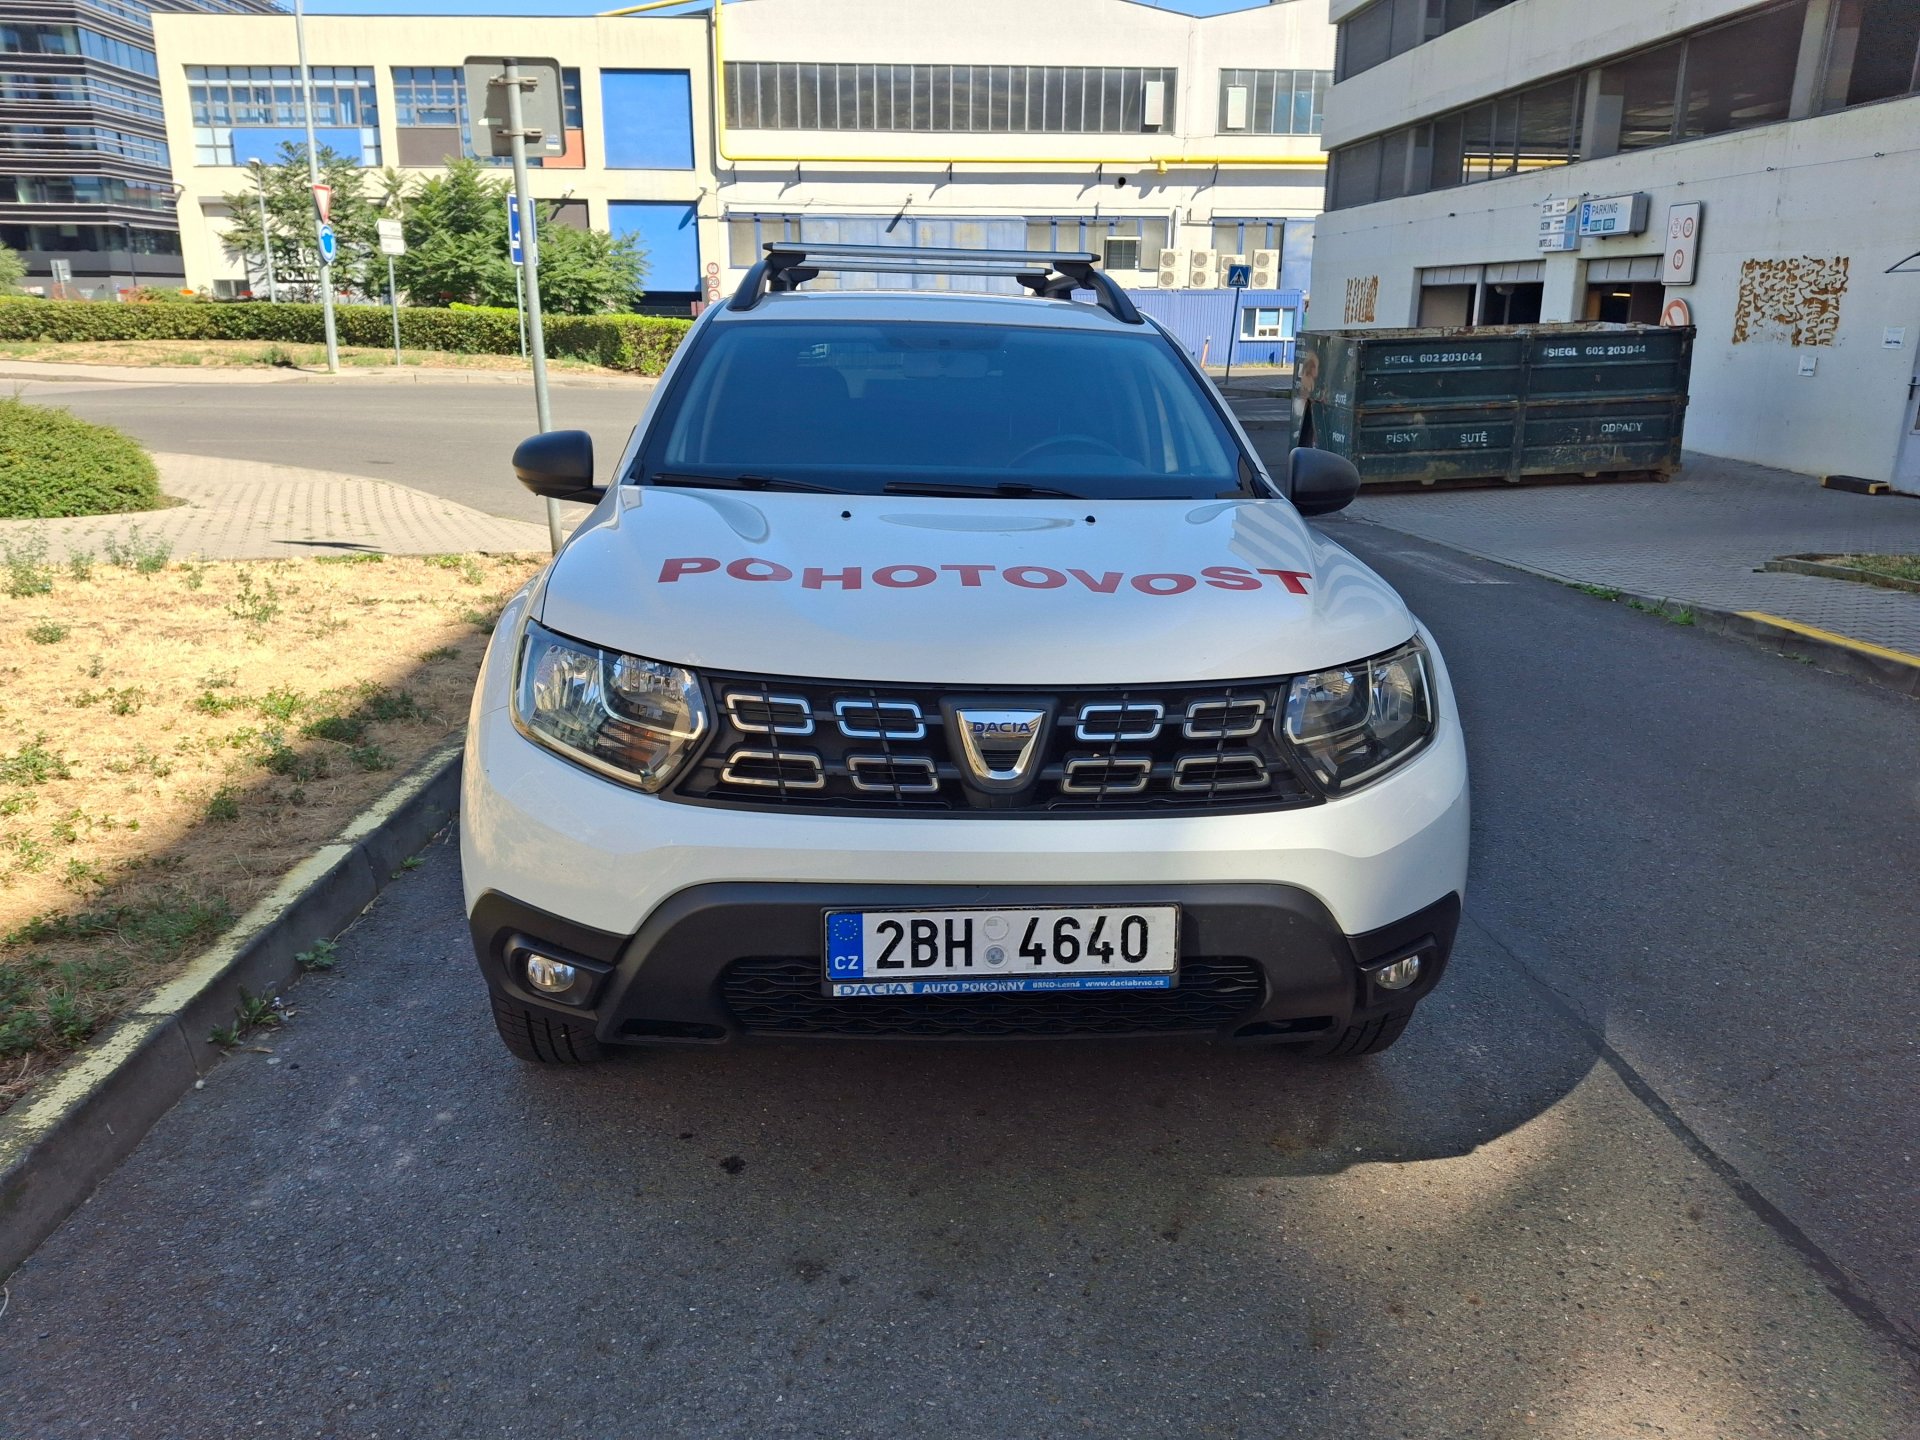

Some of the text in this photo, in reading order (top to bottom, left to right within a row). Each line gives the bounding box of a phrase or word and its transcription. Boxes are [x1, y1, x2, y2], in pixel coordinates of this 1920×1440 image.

[1591, 203, 1618, 216] PARKING
[1548, 347, 1579, 357] SIEGL
[1585, 346, 1605, 355] 602
[1384, 355, 1415, 365] SIEGL
[1419, 354, 1440, 363] 602
[1601, 422, 1643, 433] ODPADY
[1386, 432, 1419, 444] PÍSKY
[658, 556, 1312, 596] POHOTOVOST
[973, 722, 1031, 733] DACIA
[875, 914, 1150, 970] 2BH 4640
[833, 955, 859, 971] CZ
[839, 982, 908, 996] DACIA
[922, 983, 958, 993] AUTO
[961, 979, 1026, 993] POKORNÝ
[1085, 978, 1165, 988] www.daciabrno.cz
